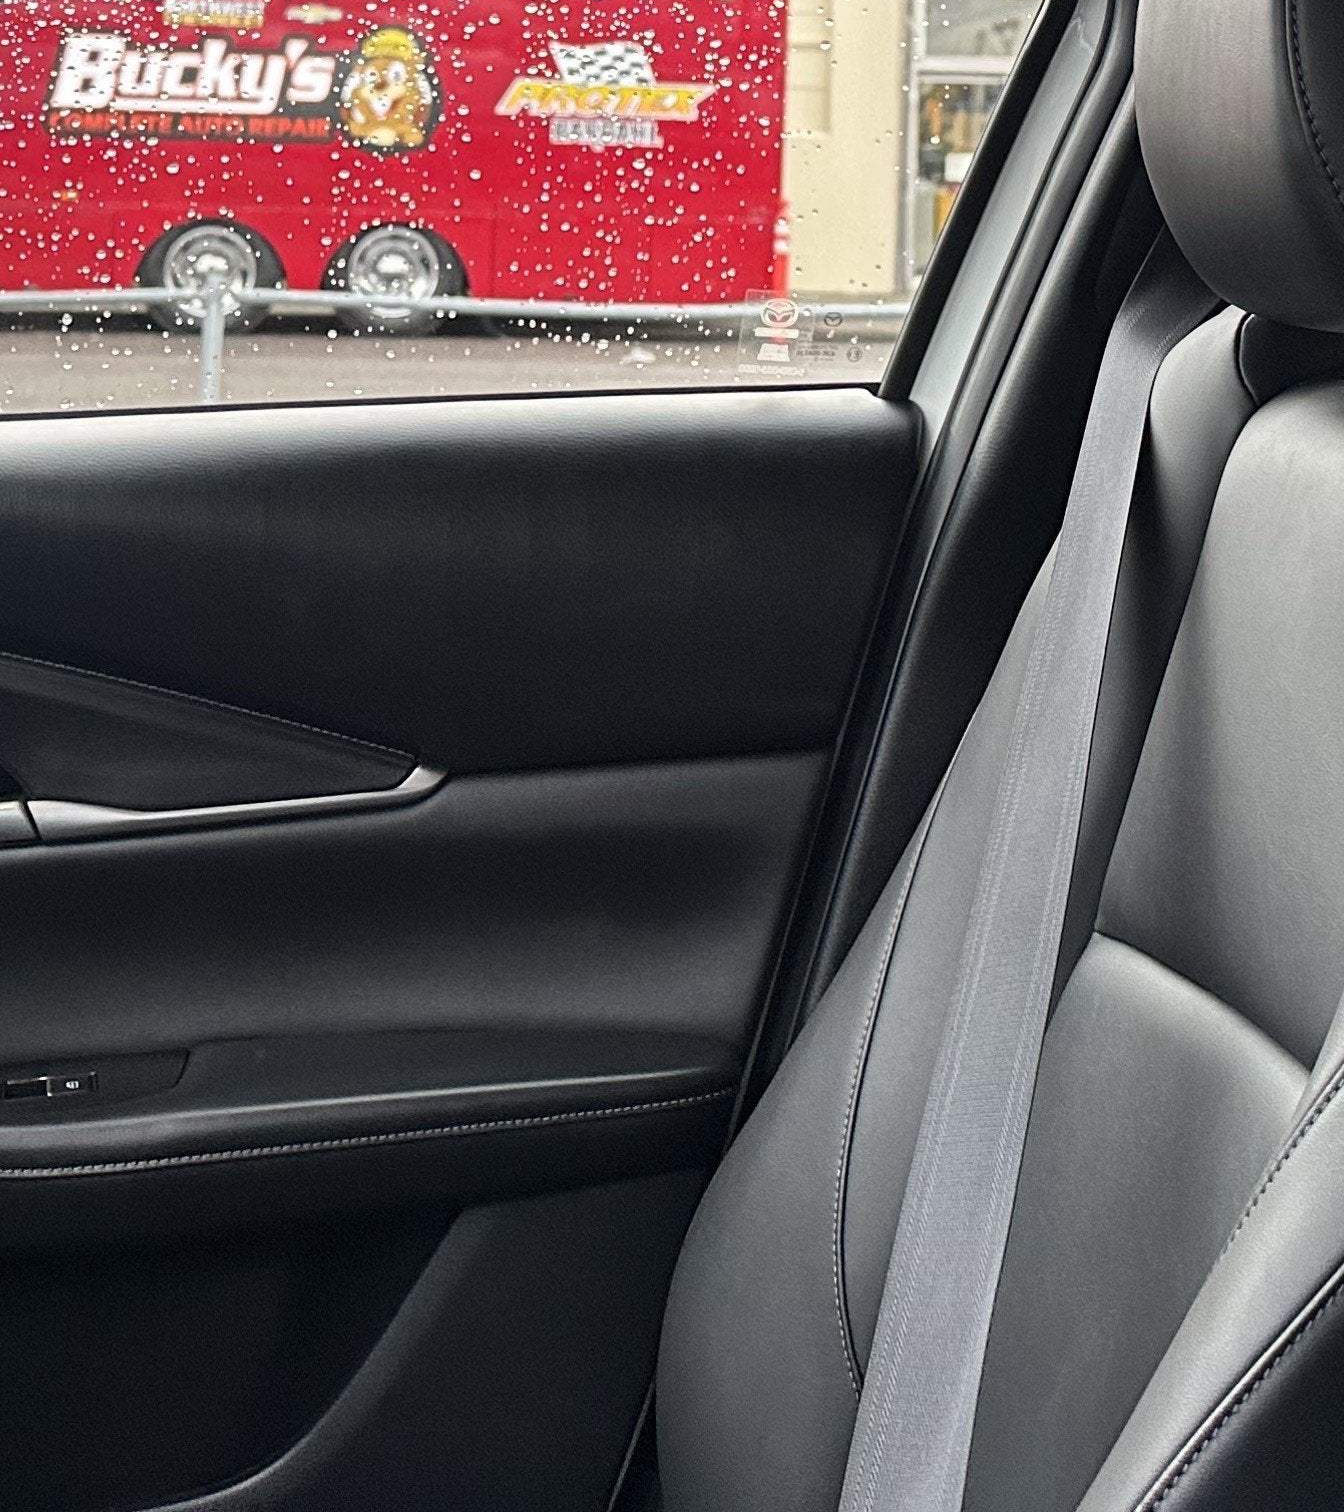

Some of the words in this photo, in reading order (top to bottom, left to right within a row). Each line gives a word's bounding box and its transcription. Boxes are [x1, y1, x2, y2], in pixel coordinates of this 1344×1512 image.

[50, 33, 336, 114] Bucky's
[47, 110, 173, 132] COMPLETE
[178, 114, 244, 134] AUTO
[248, 116, 330, 136] REPAIR
